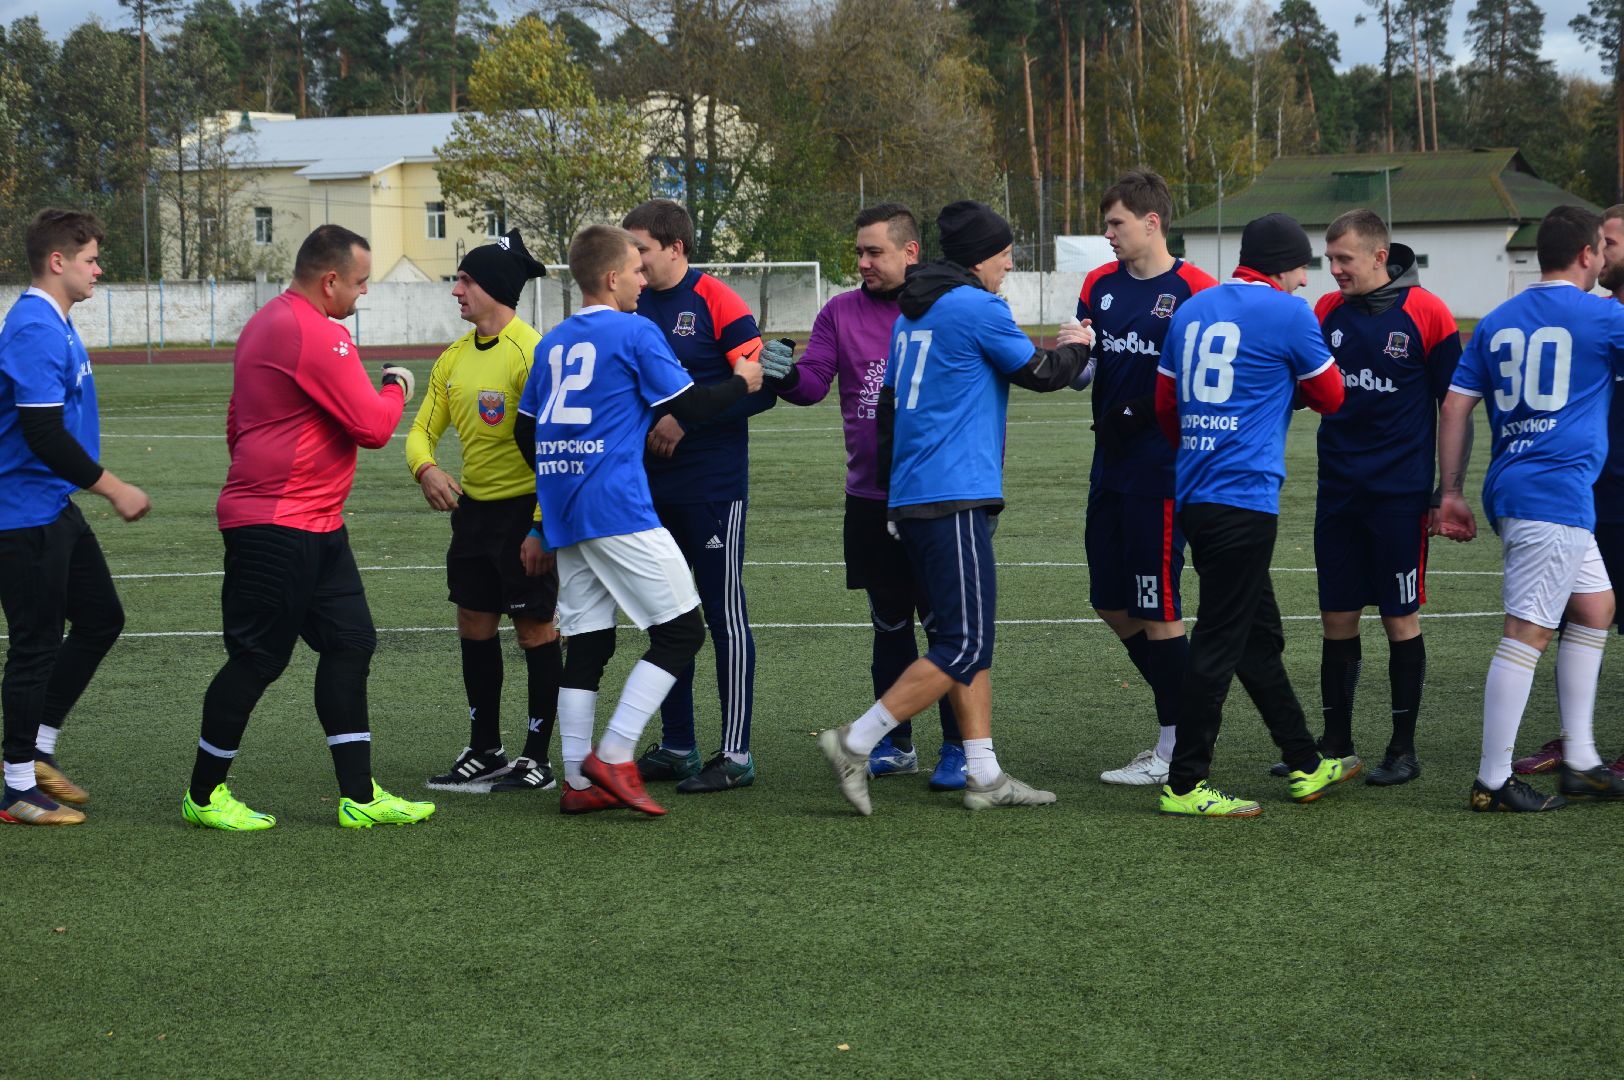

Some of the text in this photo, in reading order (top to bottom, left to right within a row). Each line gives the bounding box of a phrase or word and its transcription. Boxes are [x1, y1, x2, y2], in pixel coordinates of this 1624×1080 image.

[538, 342, 597, 425] 12
[1182, 320, 1241, 404] 18
[1489, 326, 1573, 412] 30
[538, 459, 569, 476] ПТО
[1135, 574, 1159, 609] 13
[1395, 567, 1418, 605] 10
